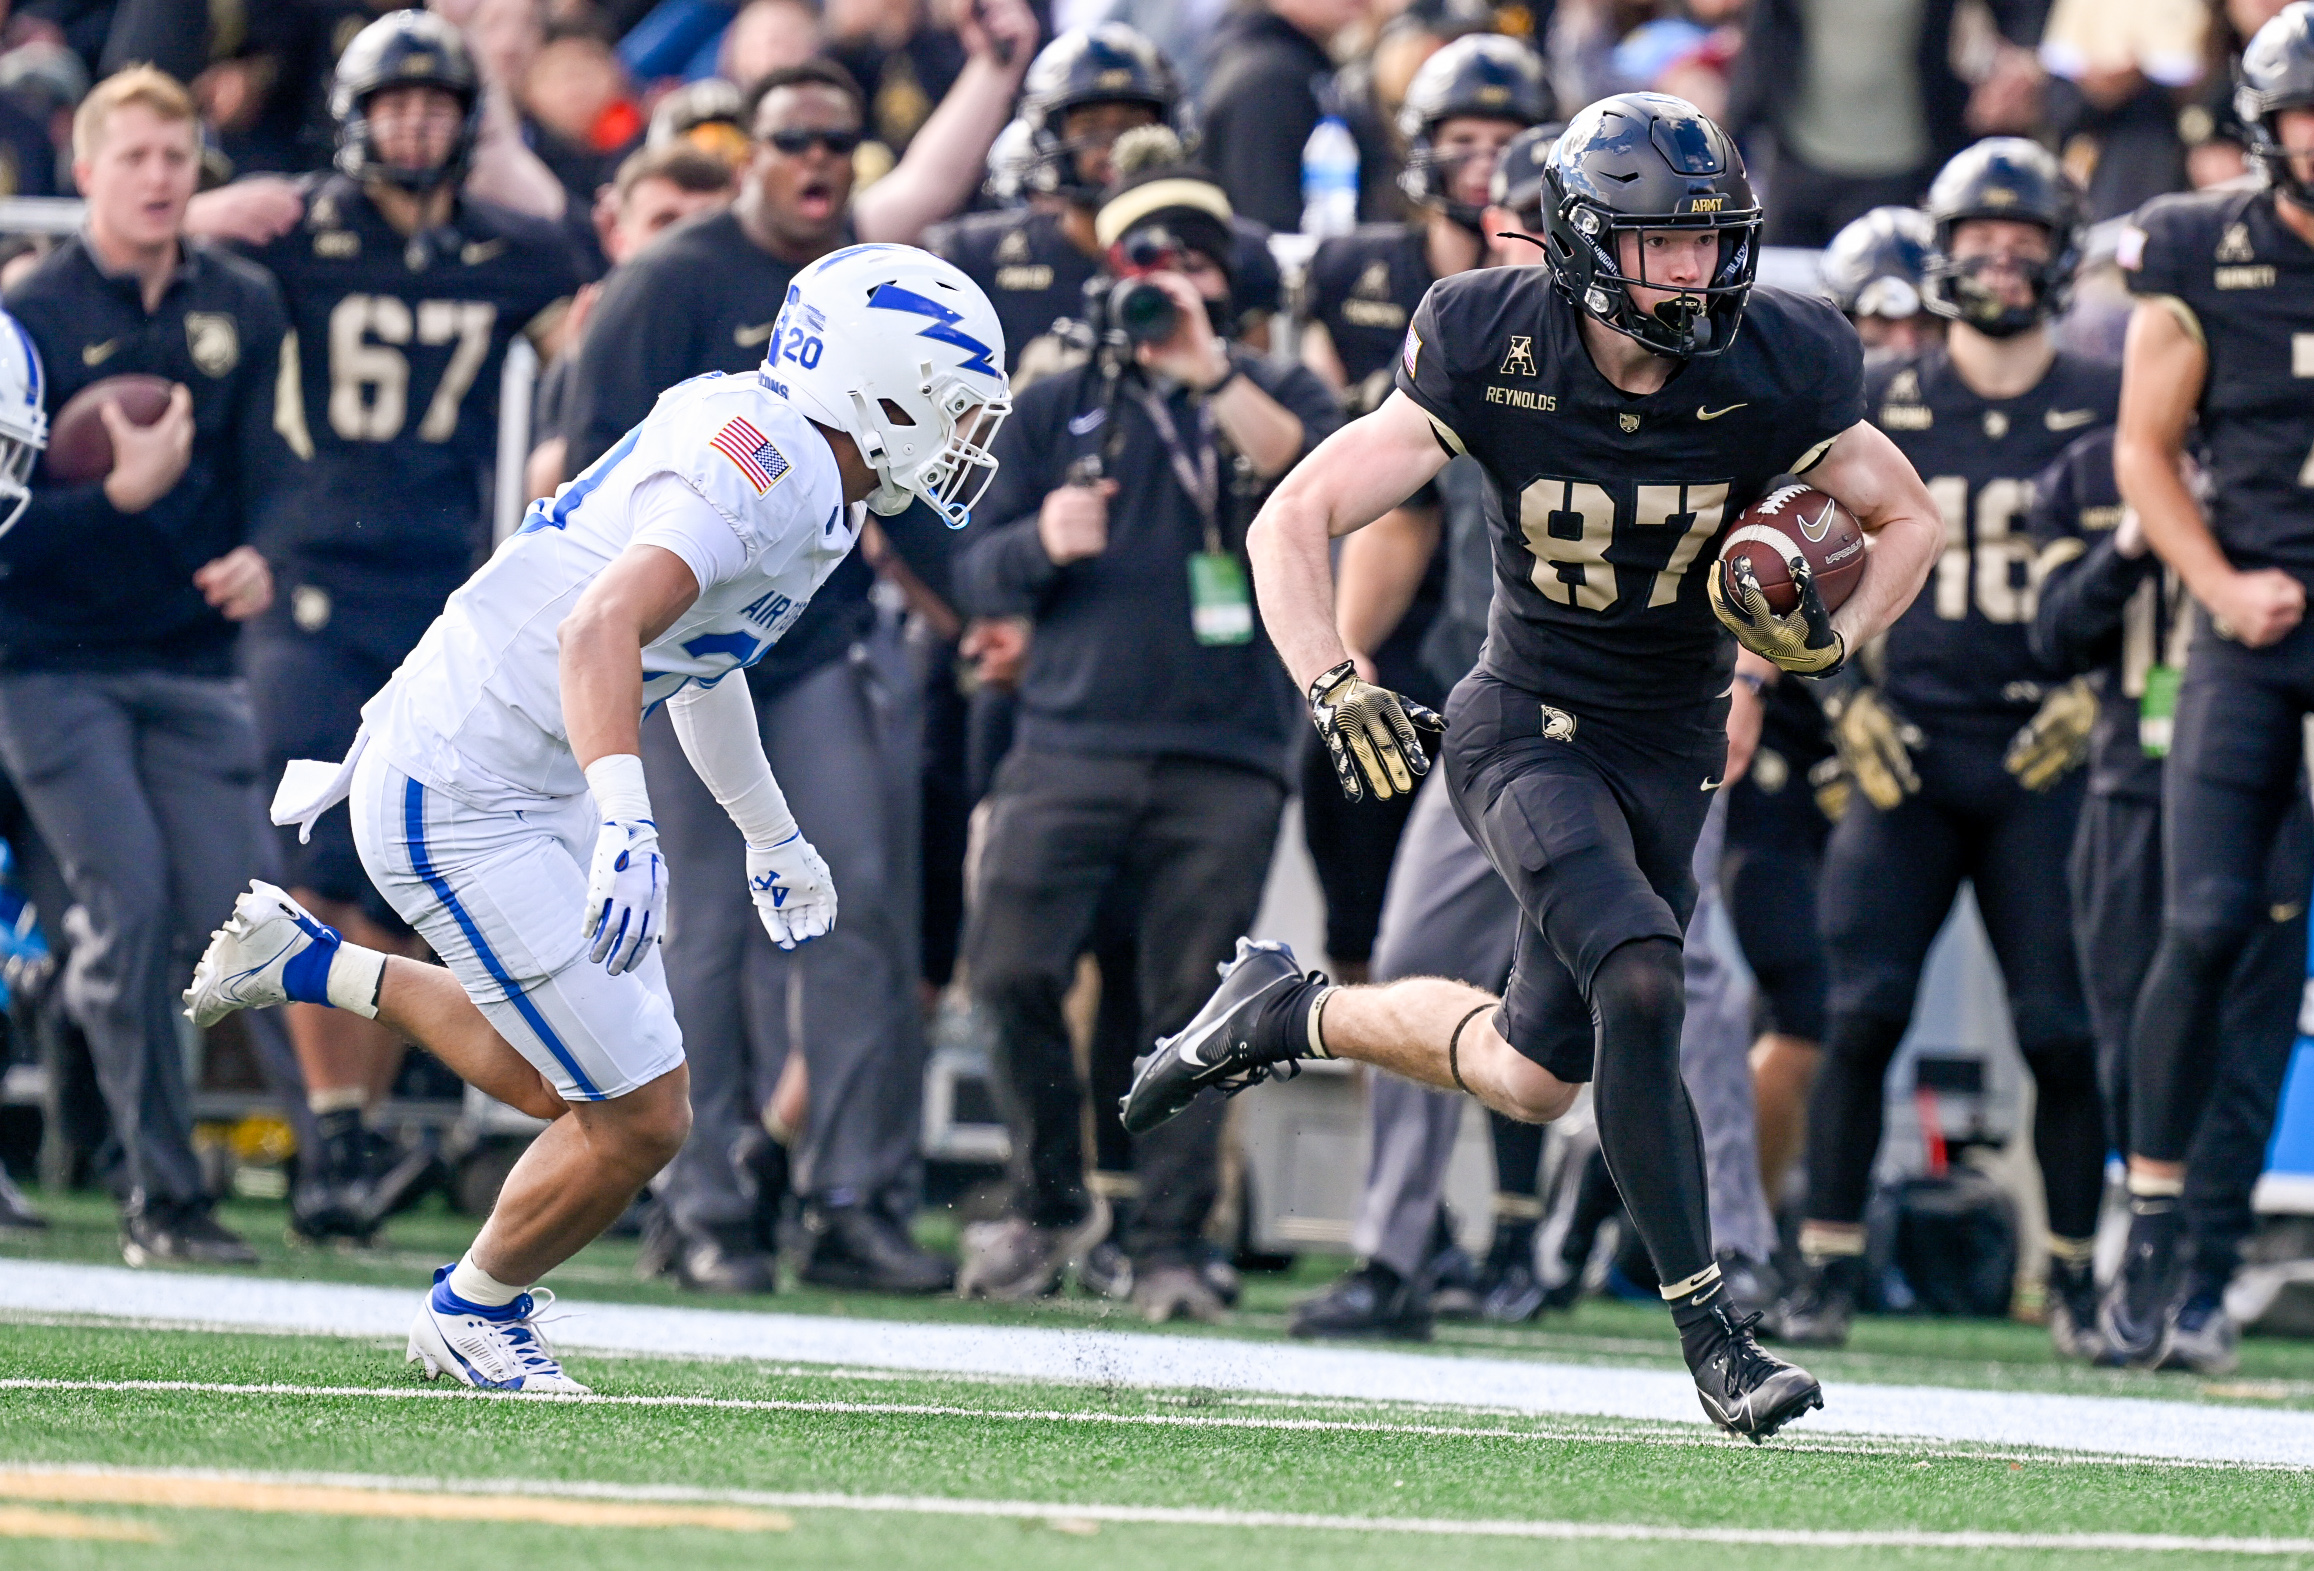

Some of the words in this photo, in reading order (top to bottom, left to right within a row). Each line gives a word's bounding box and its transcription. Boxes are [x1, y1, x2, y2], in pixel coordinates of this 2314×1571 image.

[1691, 199, 1723, 213] ARMY
[1728, 245, 1747, 274] BLACK
[328, 293, 499, 443] 67
[782, 326, 824, 371] 20
[1486, 386, 1557, 412] REYNOLDS
[1519, 475, 1735, 613] 87
[1925, 475, 2036, 624] 16
[737, 589, 792, 632] AIR
